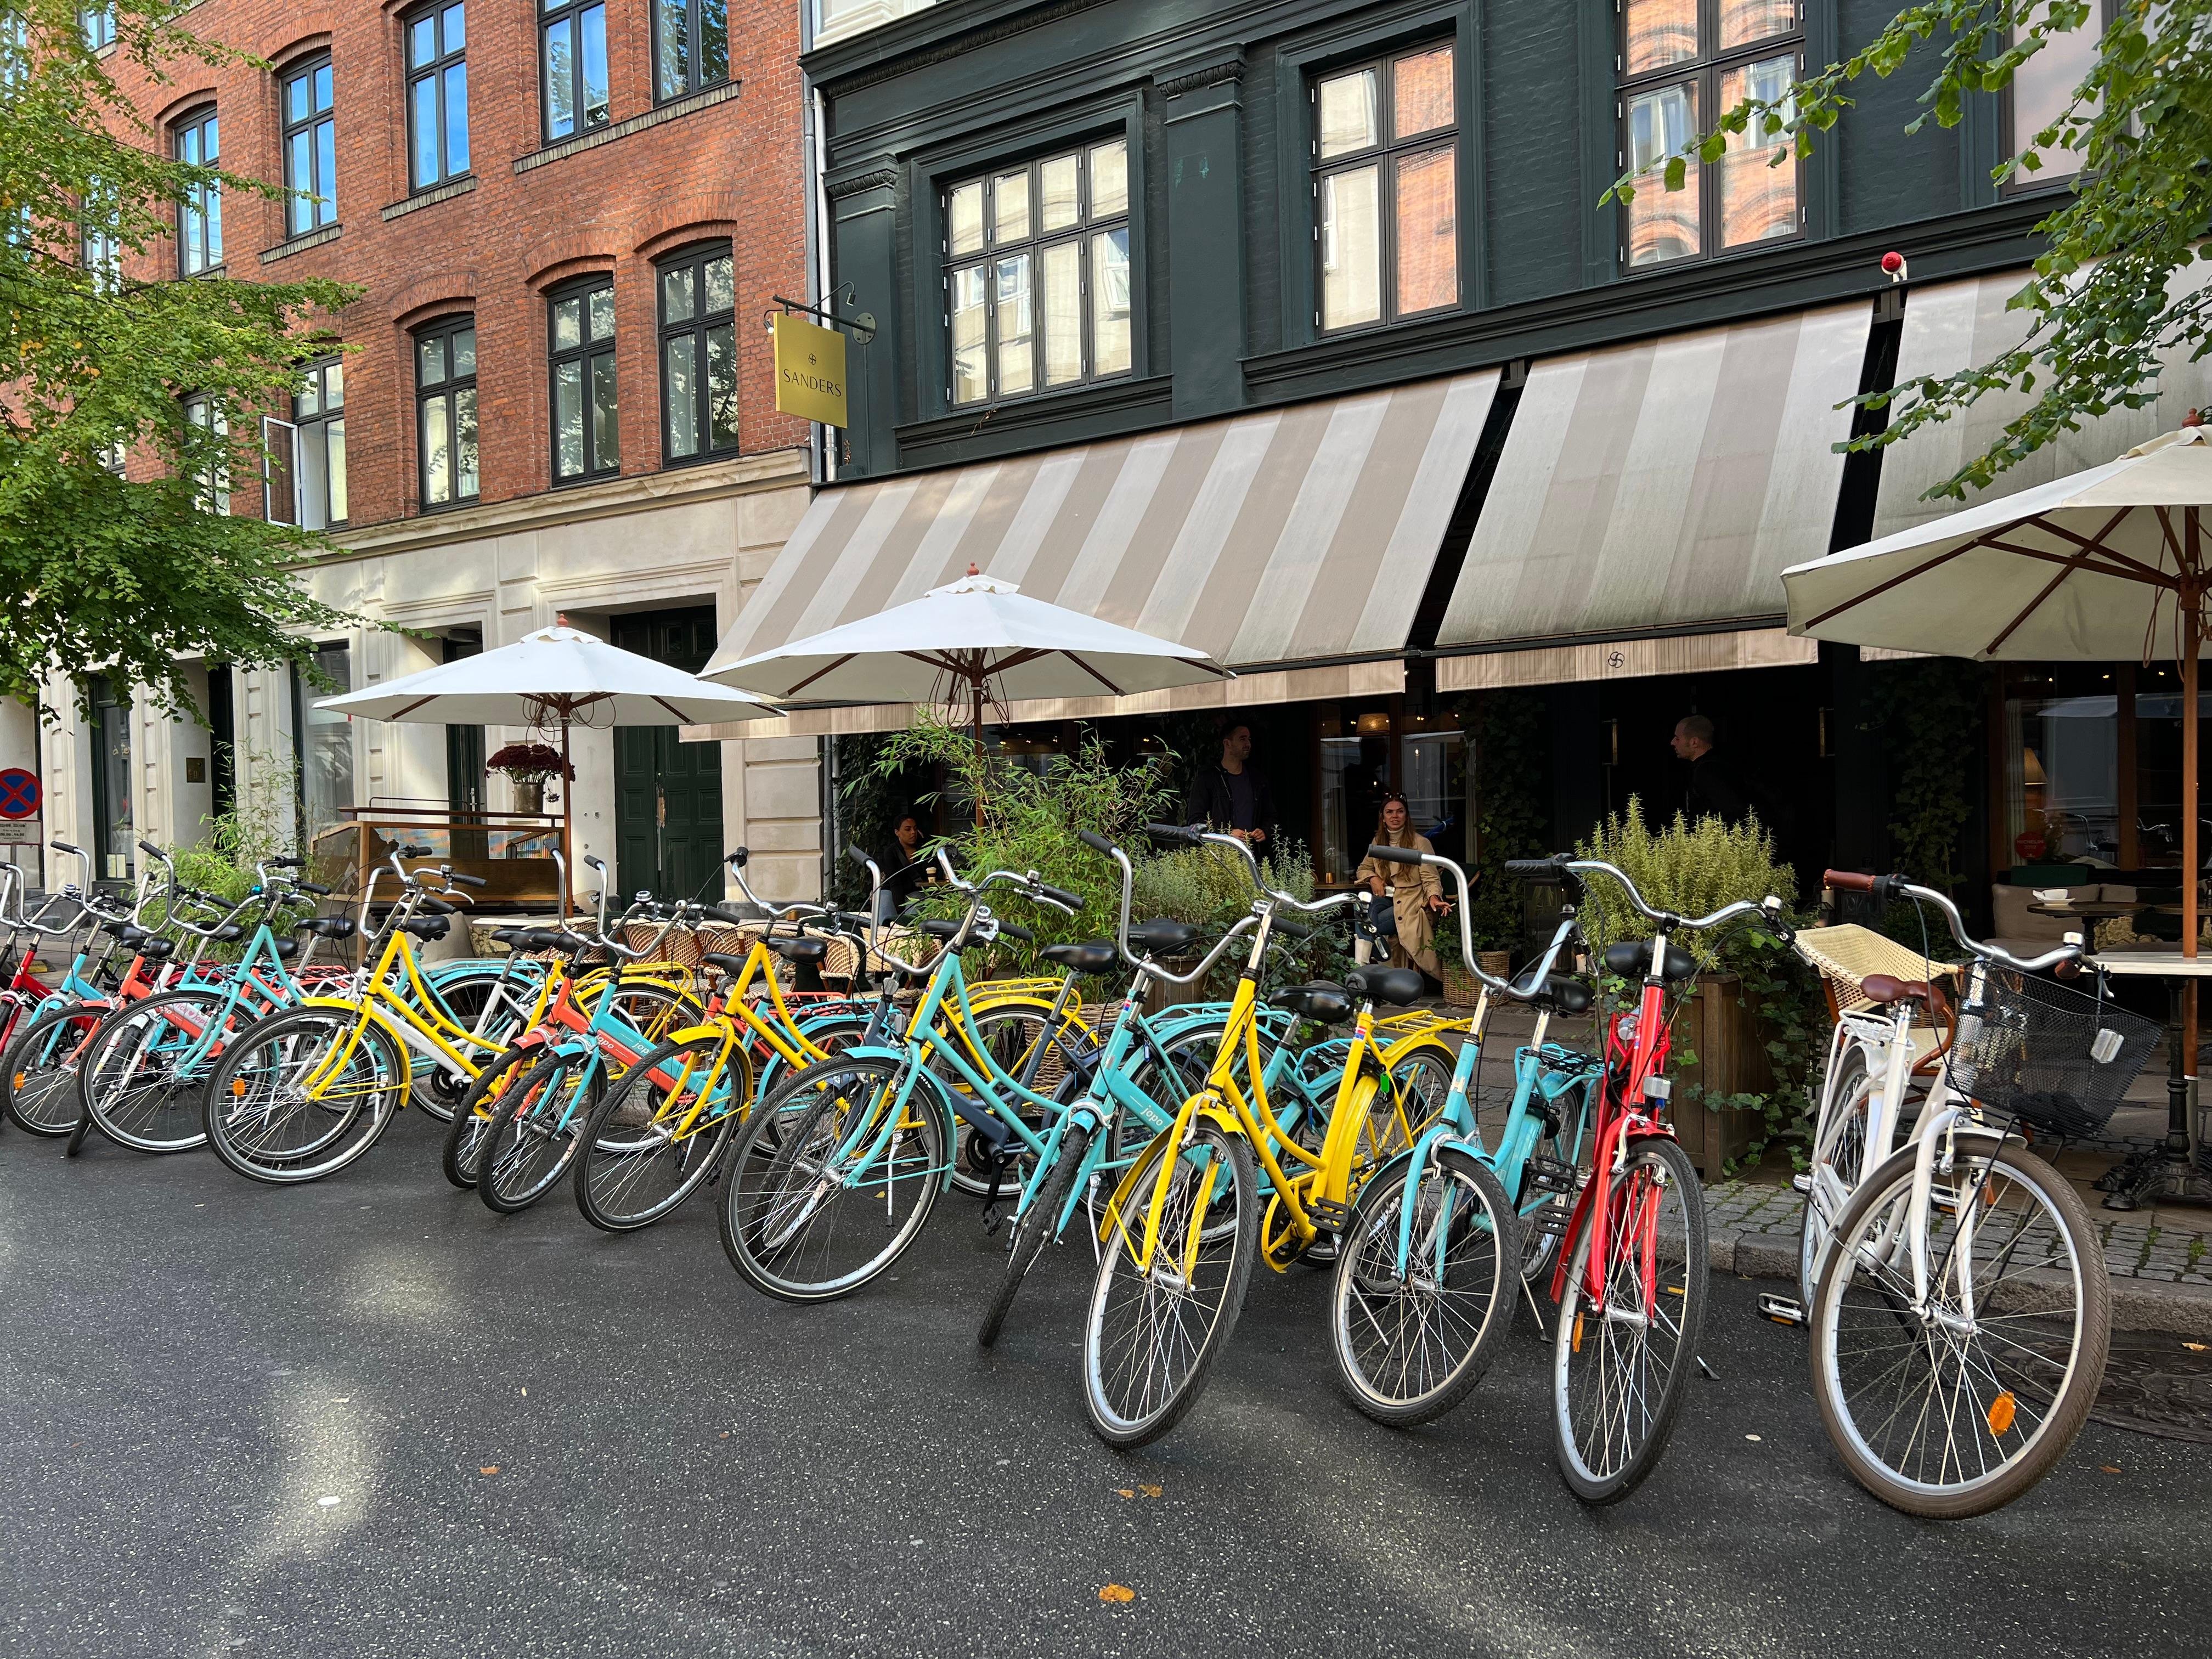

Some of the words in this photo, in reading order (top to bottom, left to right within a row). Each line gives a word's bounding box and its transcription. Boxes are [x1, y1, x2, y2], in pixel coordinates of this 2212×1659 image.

[783, 369, 842, 397] SANDERS
[631, 1040, 650, 1054] jop
[1140, 1104, 1163, 1126] jopo
